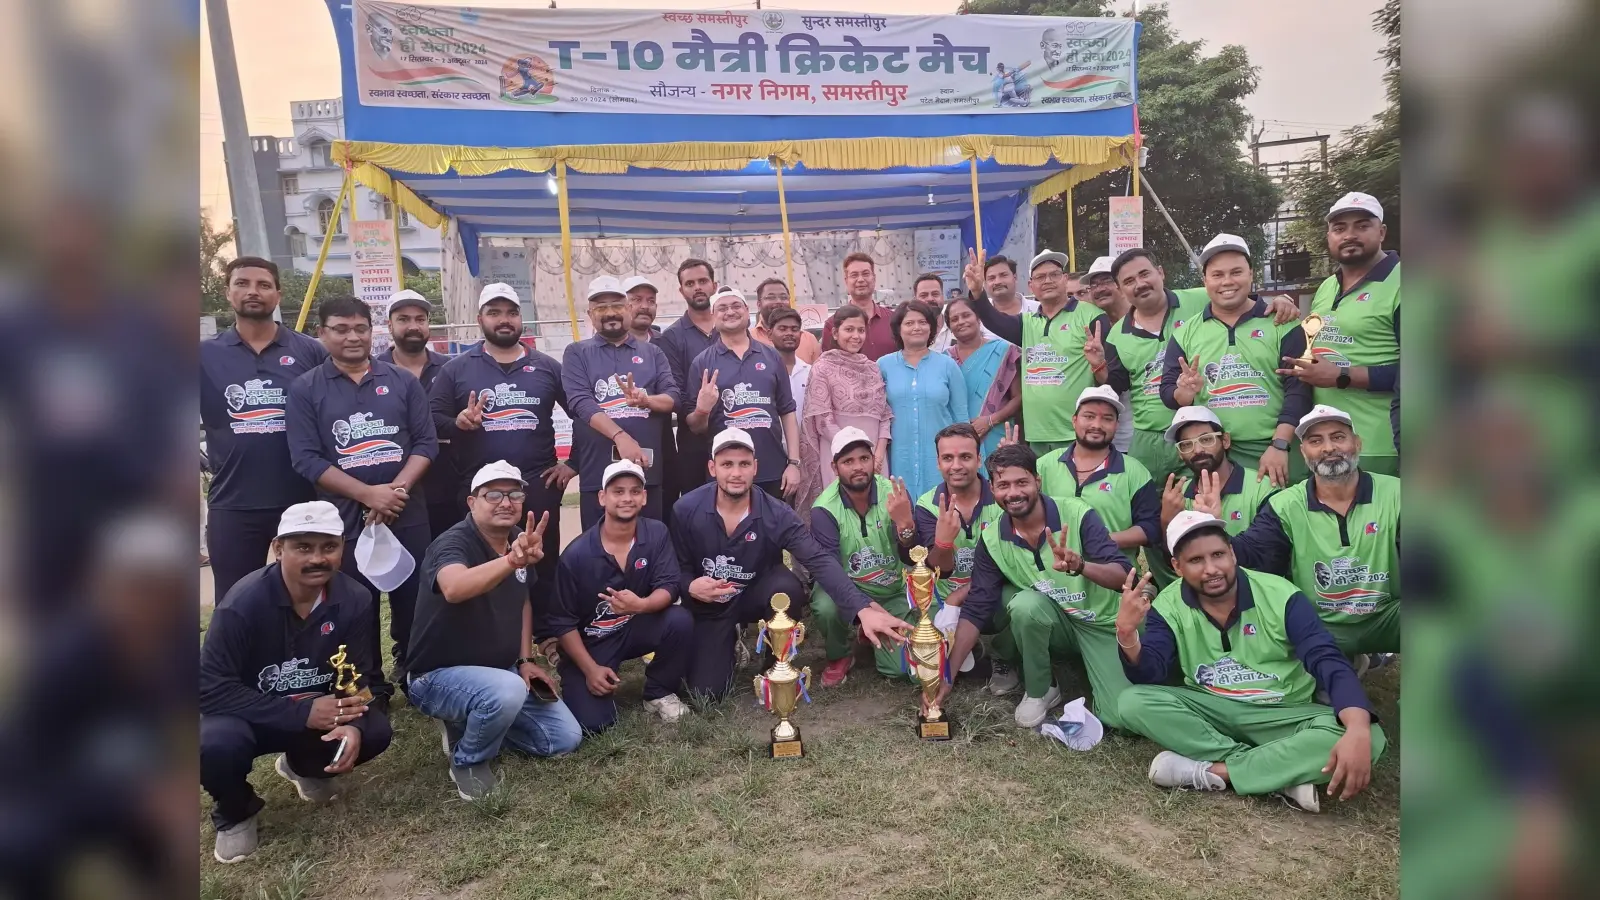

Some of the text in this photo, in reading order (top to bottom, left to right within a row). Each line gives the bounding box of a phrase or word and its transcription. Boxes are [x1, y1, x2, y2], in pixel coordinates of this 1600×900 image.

[661, 10, 749, 28] स्वच्छ समस्तीपुर
[801, 14, 887, 32] सुन्दर समस्तीपुर
[399, 24, 454, 37] स्वच्छता
[399, 37, 487, 55] ही सेवा 2024
[1065, 37, 1108, 49] स्वच्छता
[548, 40, 665, 71] T-10
[672, 28, 769, 73] मैत्री
[775, 32, 910, 76] क्रिकेट
[1065, 48, 1131, 64] ही सेवा 2024
[368, 88, 491, 101] स्वभाव स्वच्छता, संस्कार स्वच्छता
[648, 80, 697, 98] सौजन्य
[711, 83, 754, 101] नगर
[758, 79, 817, 105] निगम,
[821, 80, 909, 106] समस्तीपुर
[361, 284, 393, 292] संस्कार
[1334, 335, 1354, 344] 2024
[1220, 370, 1231, 380] ही
[1232, 369, 1249, 378] सेवा
[1334, 575, 1348, 585] ही
[1067, 590, 1087, 602] 2024
[313, 672, 334, 685] 202
[1217, 673, 1230, 685] ही
[1232, 671, 1255, 683] सेवा
